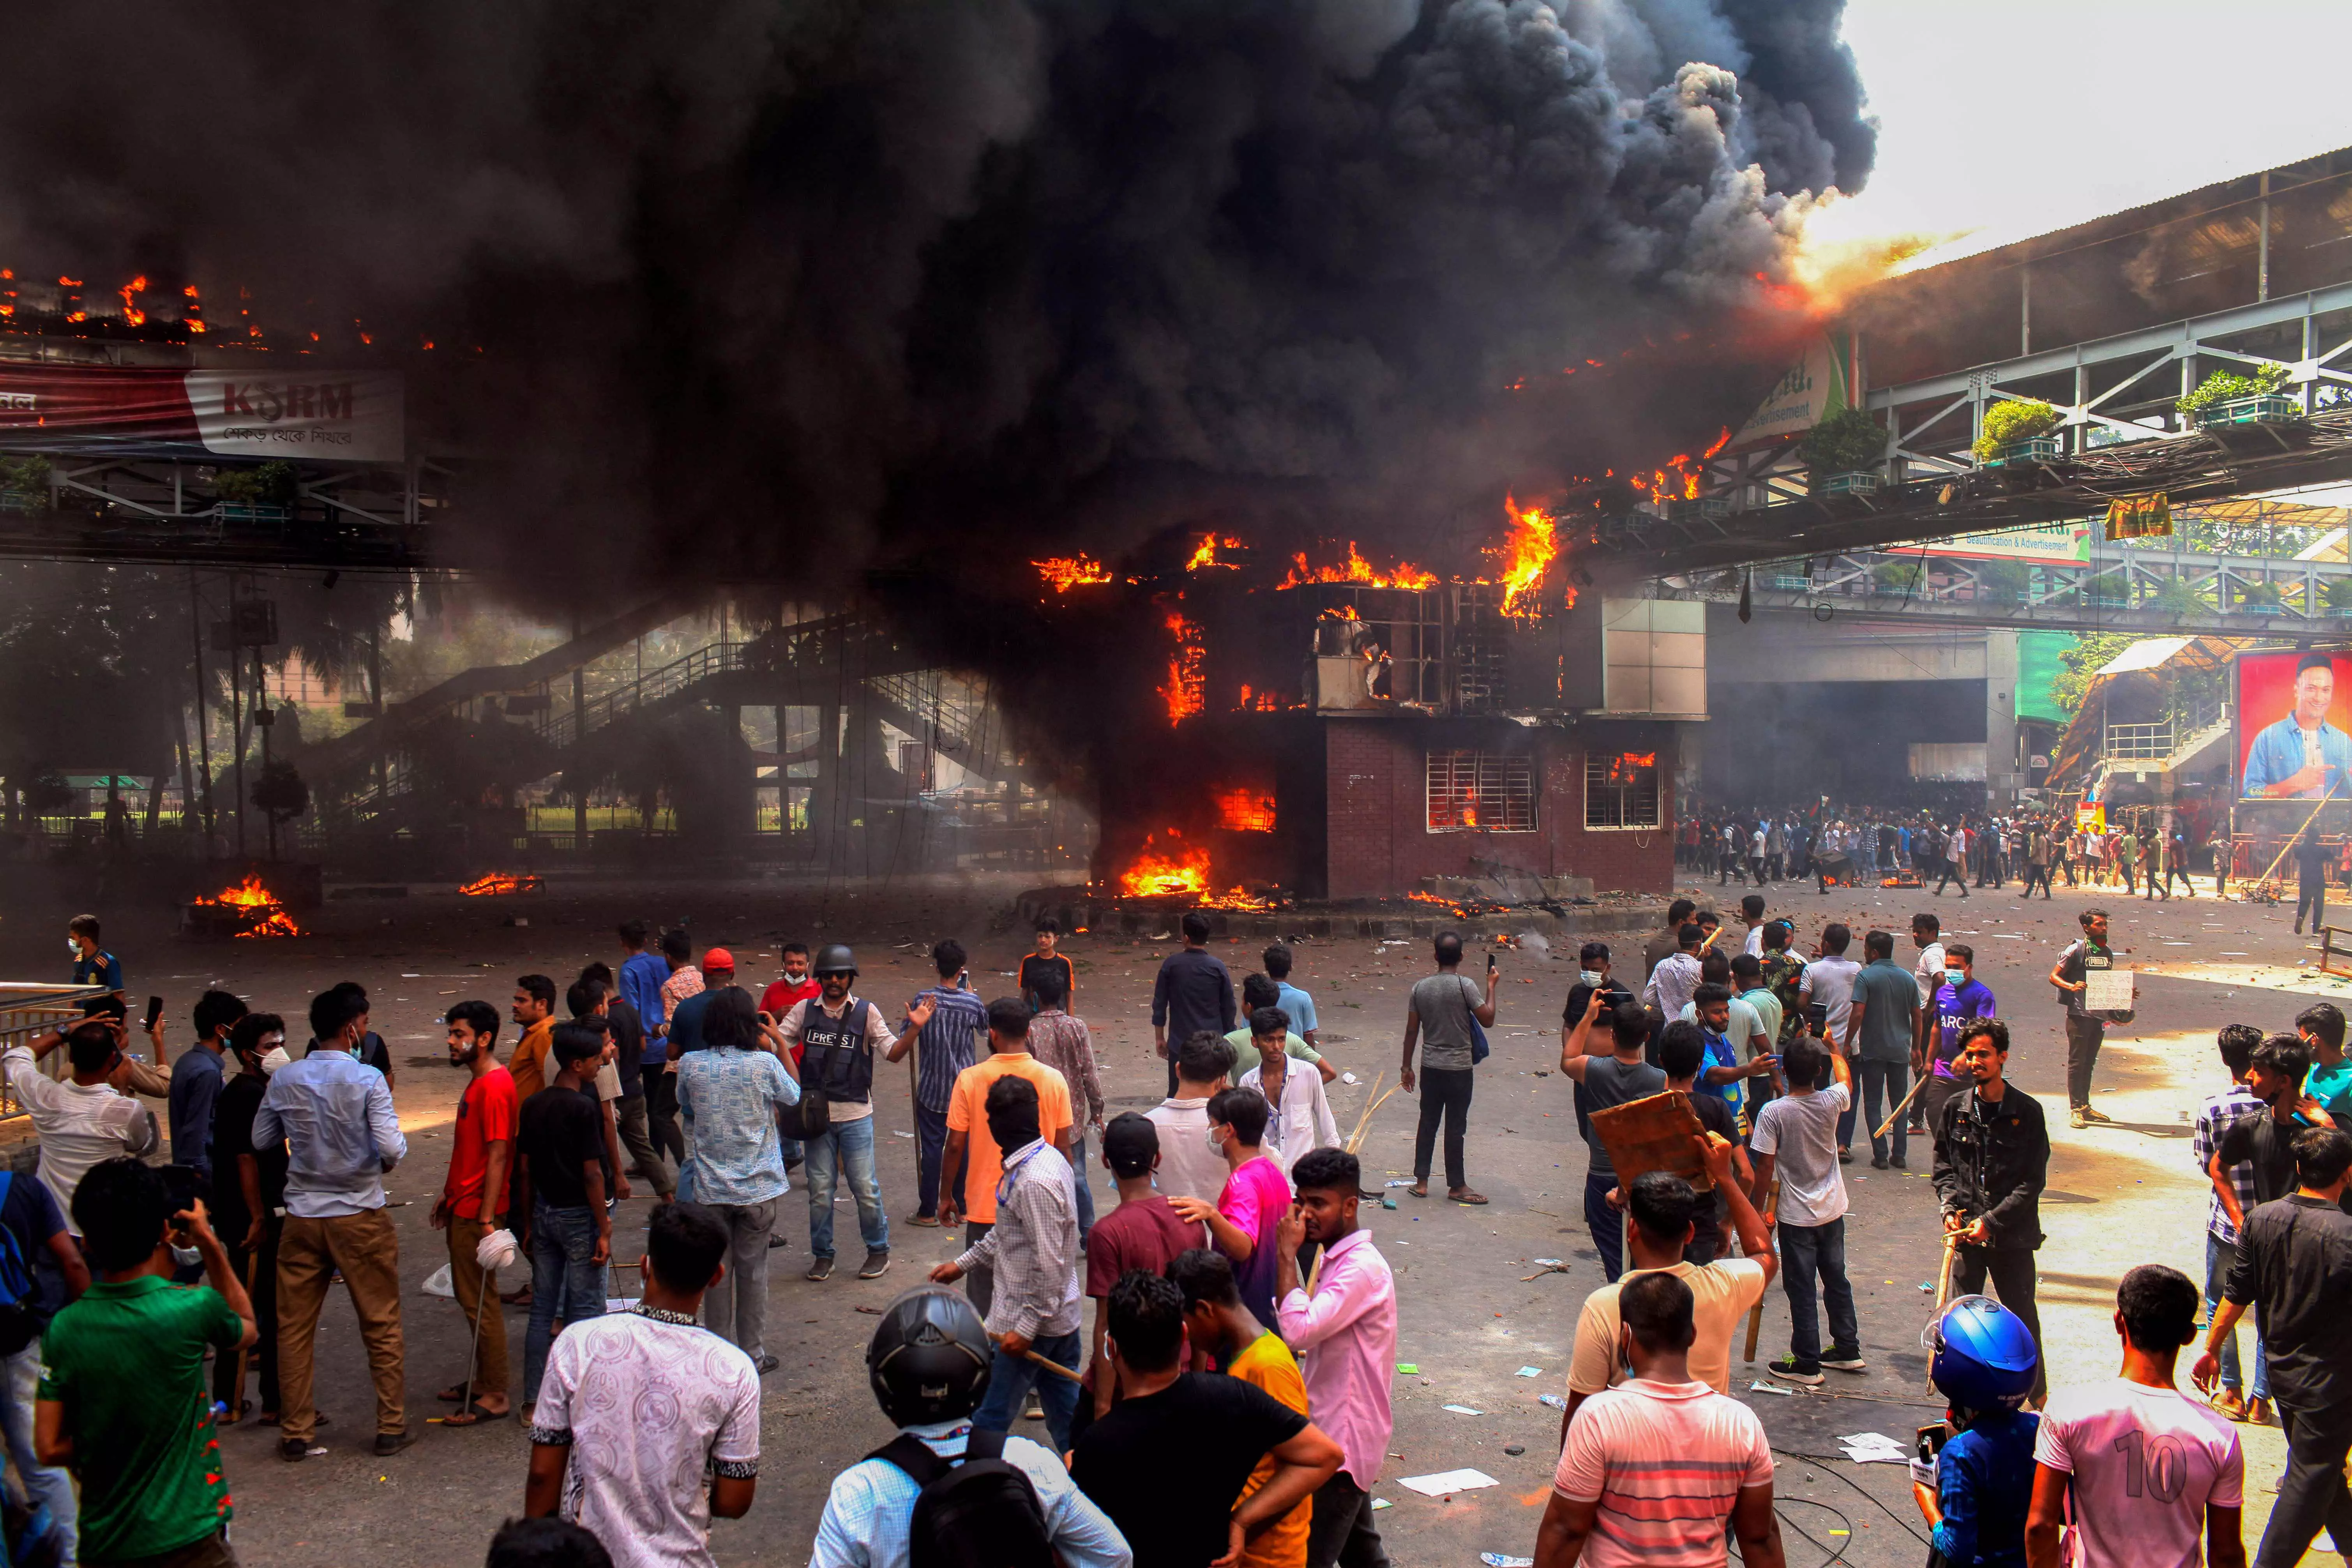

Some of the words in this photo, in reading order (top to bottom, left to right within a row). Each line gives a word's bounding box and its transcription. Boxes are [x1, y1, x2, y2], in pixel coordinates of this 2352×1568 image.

[223, 382, 352, 421] KSRM
[223, 427, 268, 442] শেকড়
[272, 429, 305, 442] থেকে
[311, 427, 352, 444] শিখরে
[1966, 533, 2013, 547] Beautification
[2014, 539, 2020, 547] &
[2021, 539, 2068, 551] Advertisement
[812, 1032, 849, 1045] PRES
[2114, 1429, 2187, 1504] 10
